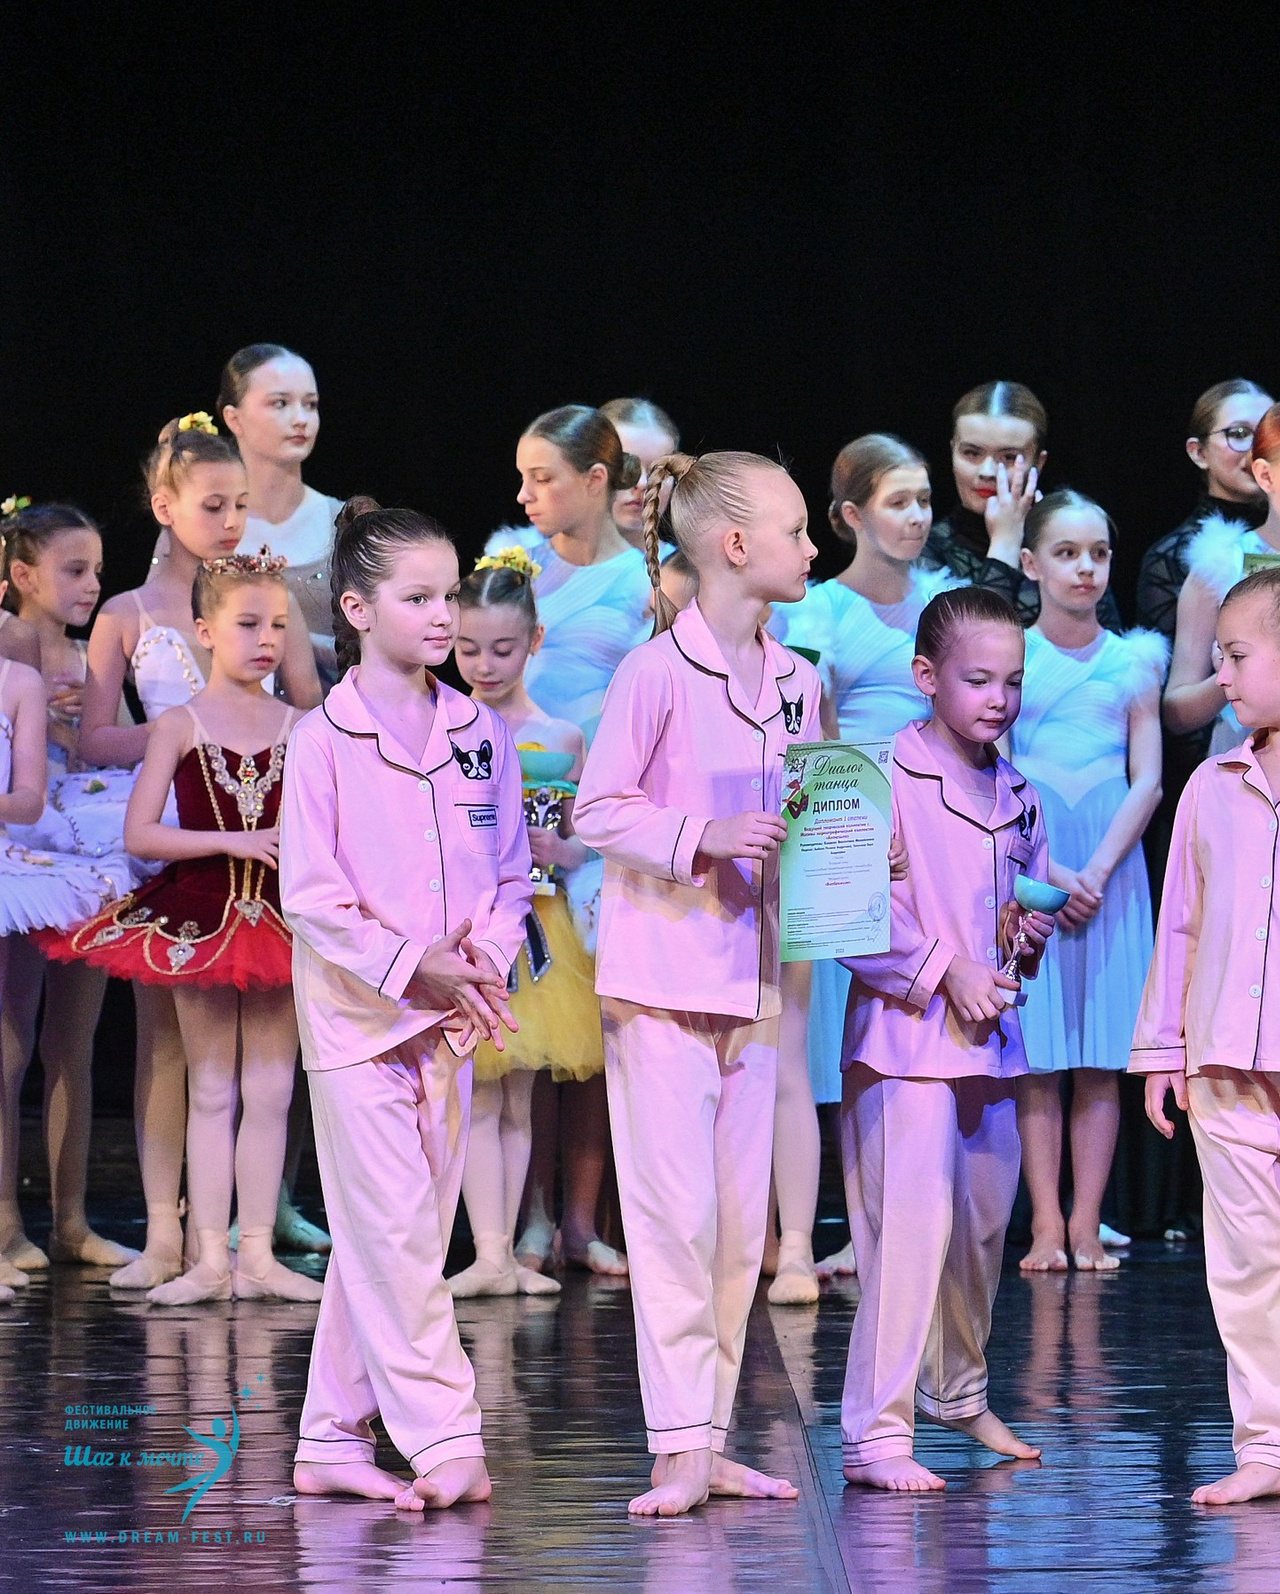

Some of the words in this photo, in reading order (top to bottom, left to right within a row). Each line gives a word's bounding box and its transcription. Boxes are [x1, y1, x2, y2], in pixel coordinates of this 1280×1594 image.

[812, 754, 864, 776] Диалог
[814, 778, 859, 792] танца
[812, 798, 860, 815] ДИПЛОМ
[472, 814, 495, 823] Suprem
